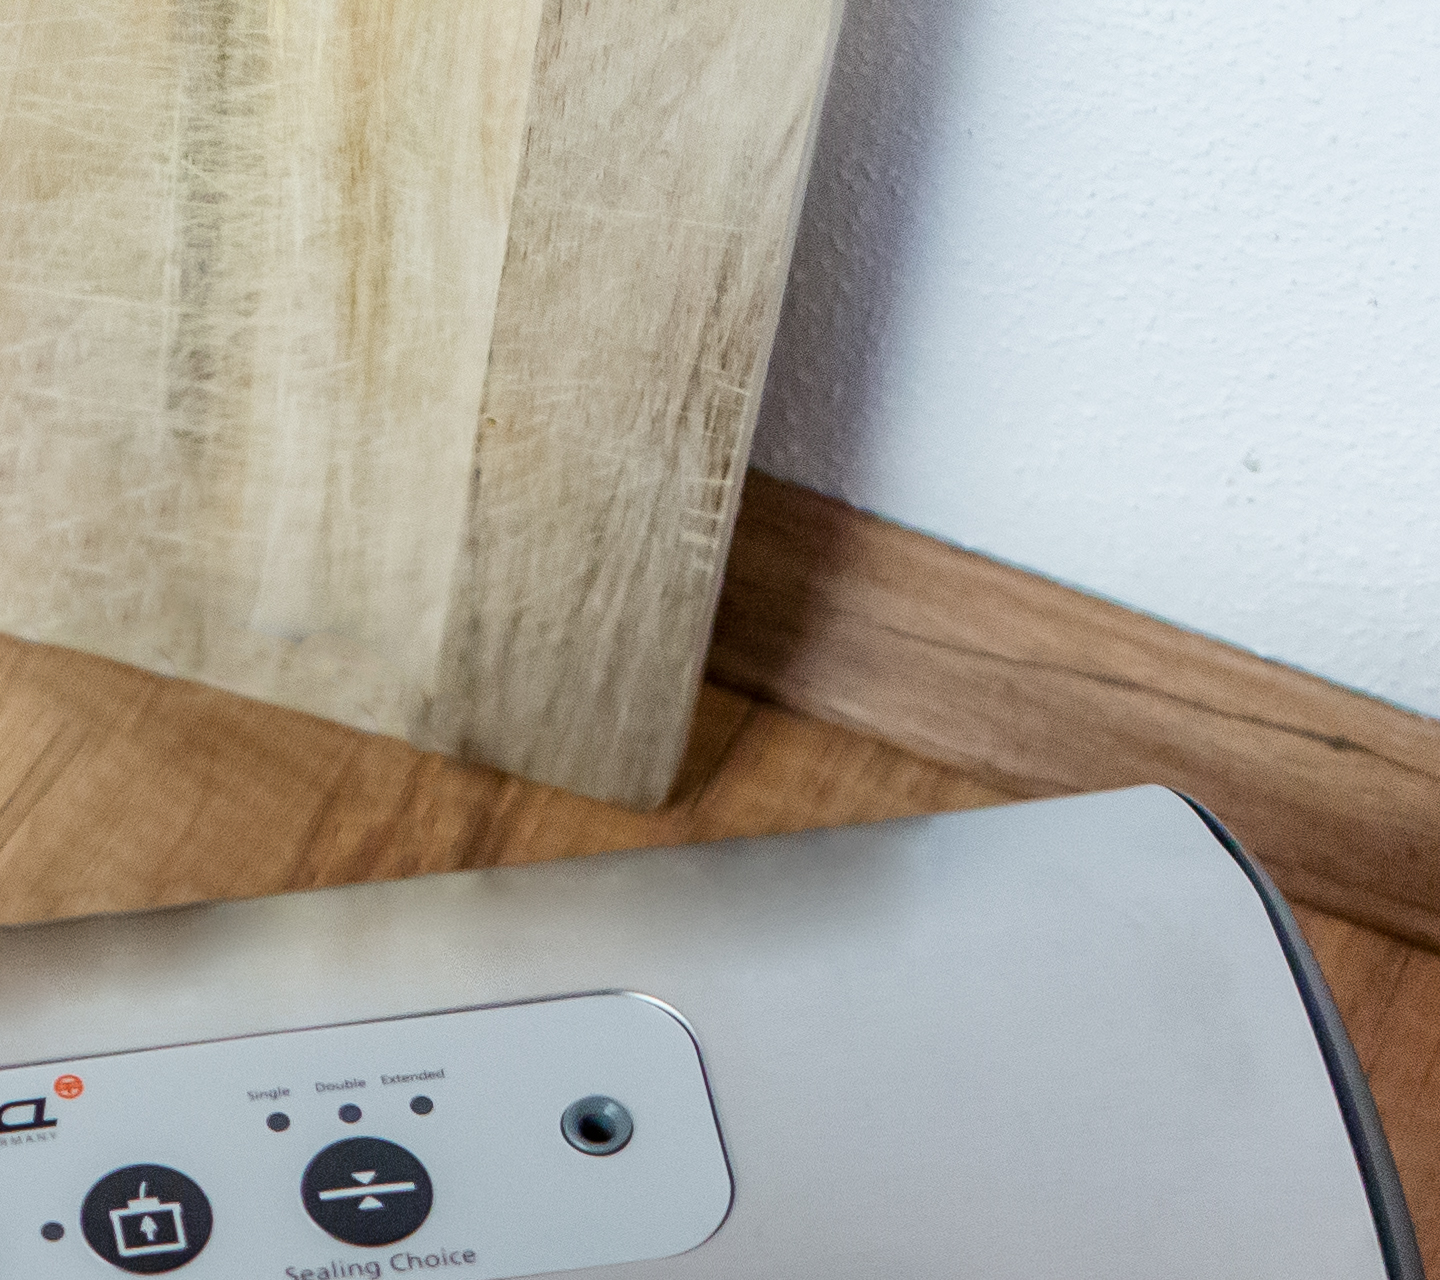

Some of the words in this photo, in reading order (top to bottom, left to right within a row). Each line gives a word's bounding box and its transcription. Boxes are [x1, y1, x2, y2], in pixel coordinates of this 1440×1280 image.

[380, 1068, 446, 1086] Extended
[315, 1078, 366, 1093] Double
[247, 1087, 290, 1102] Single
[390, 1248, 477, 1272] Choice
